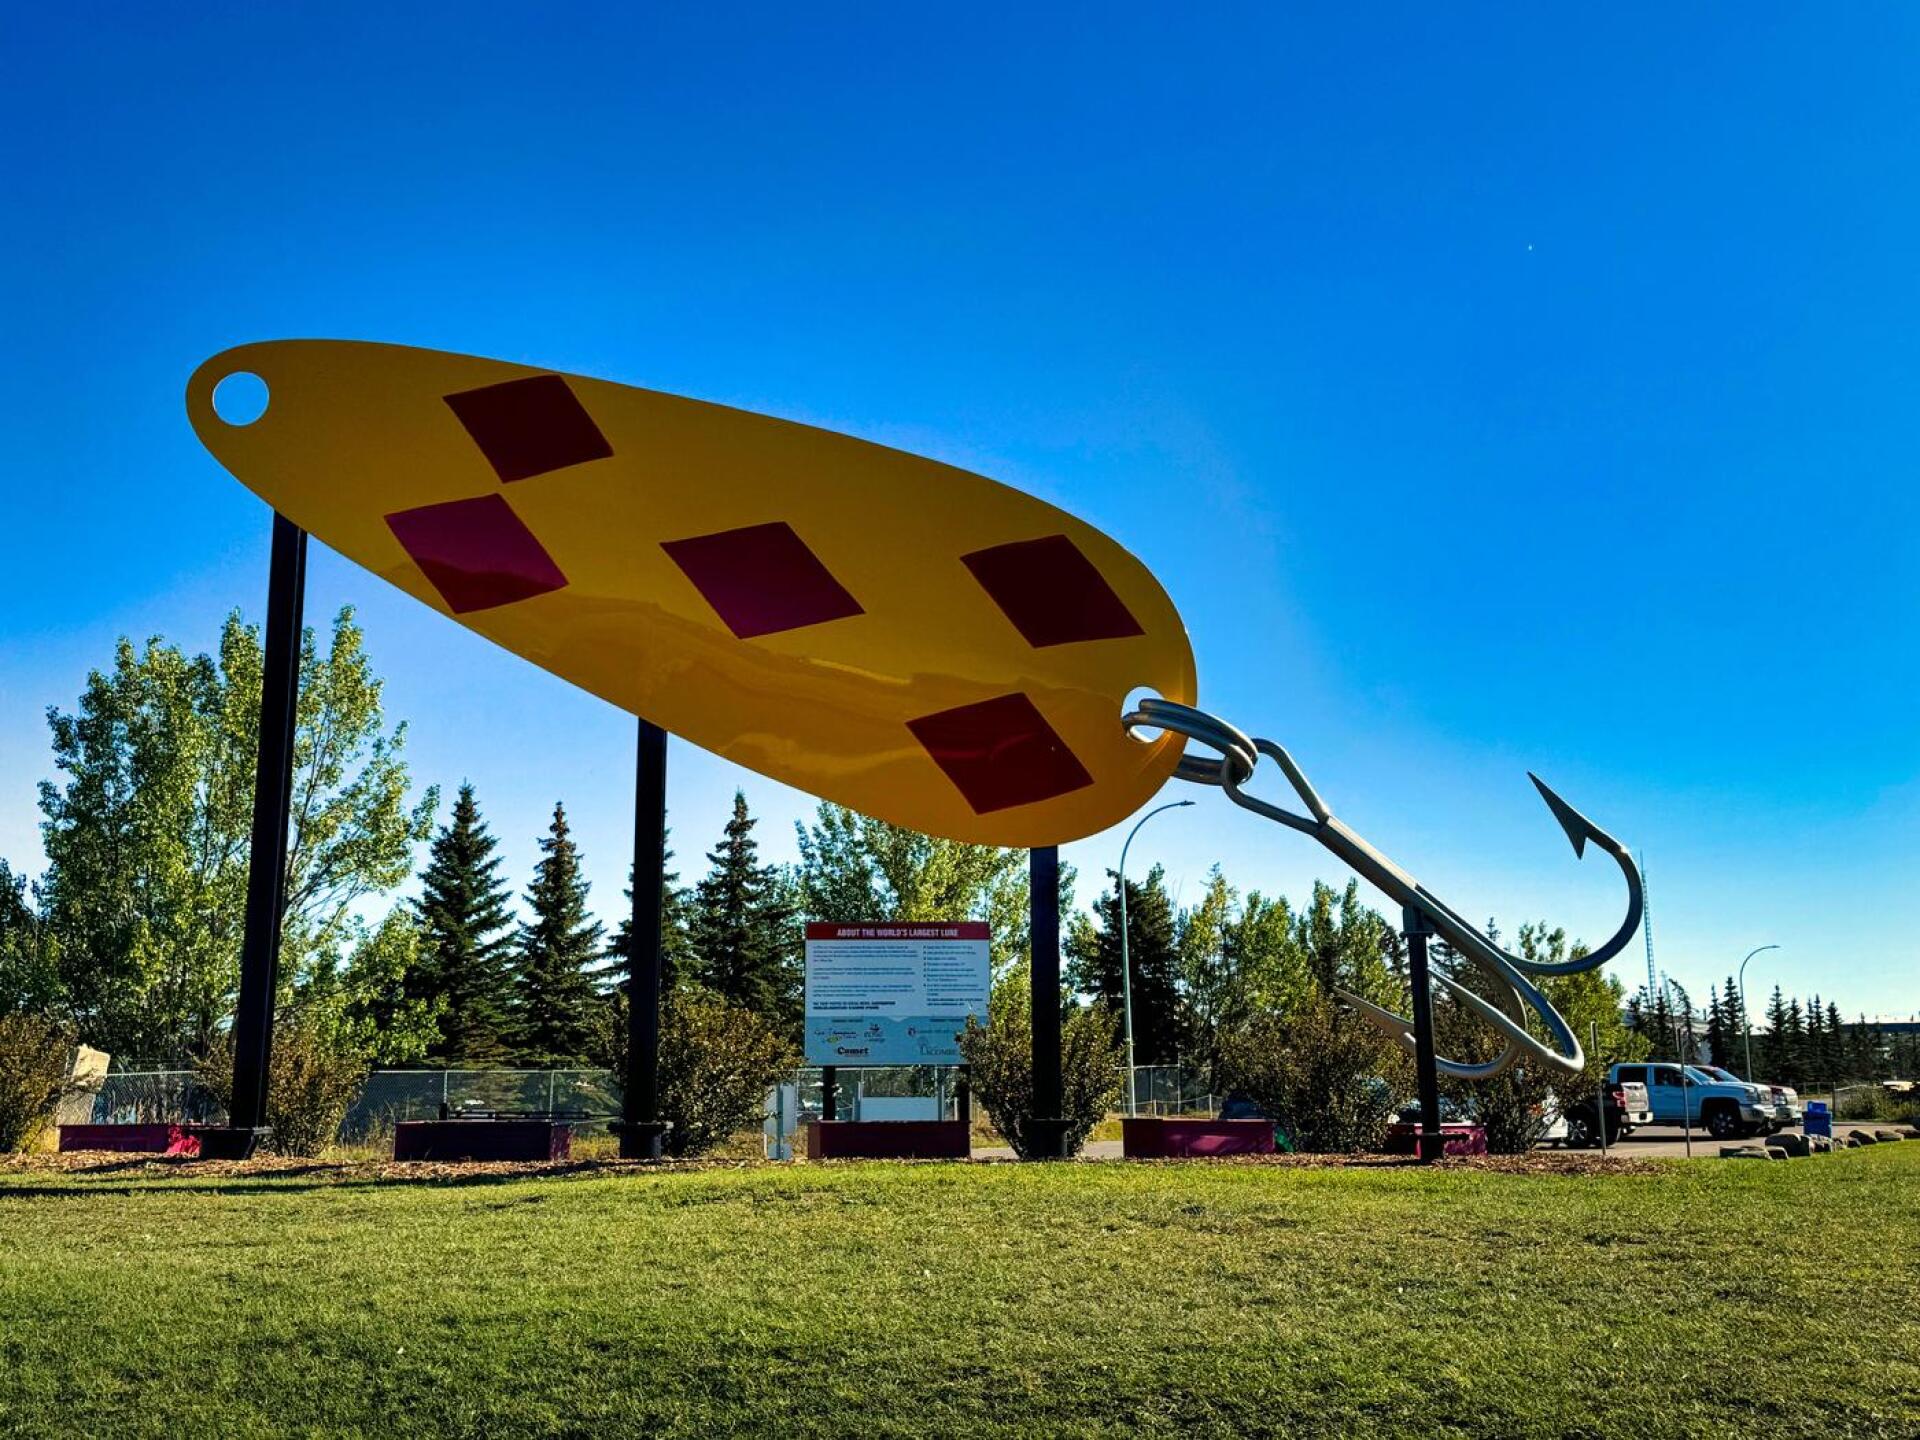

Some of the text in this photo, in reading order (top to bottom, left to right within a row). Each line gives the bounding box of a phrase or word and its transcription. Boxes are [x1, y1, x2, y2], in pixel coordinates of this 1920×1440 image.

[837, 928, 958, 937] ABOUT THE WORLD'S LARGEST LURE
